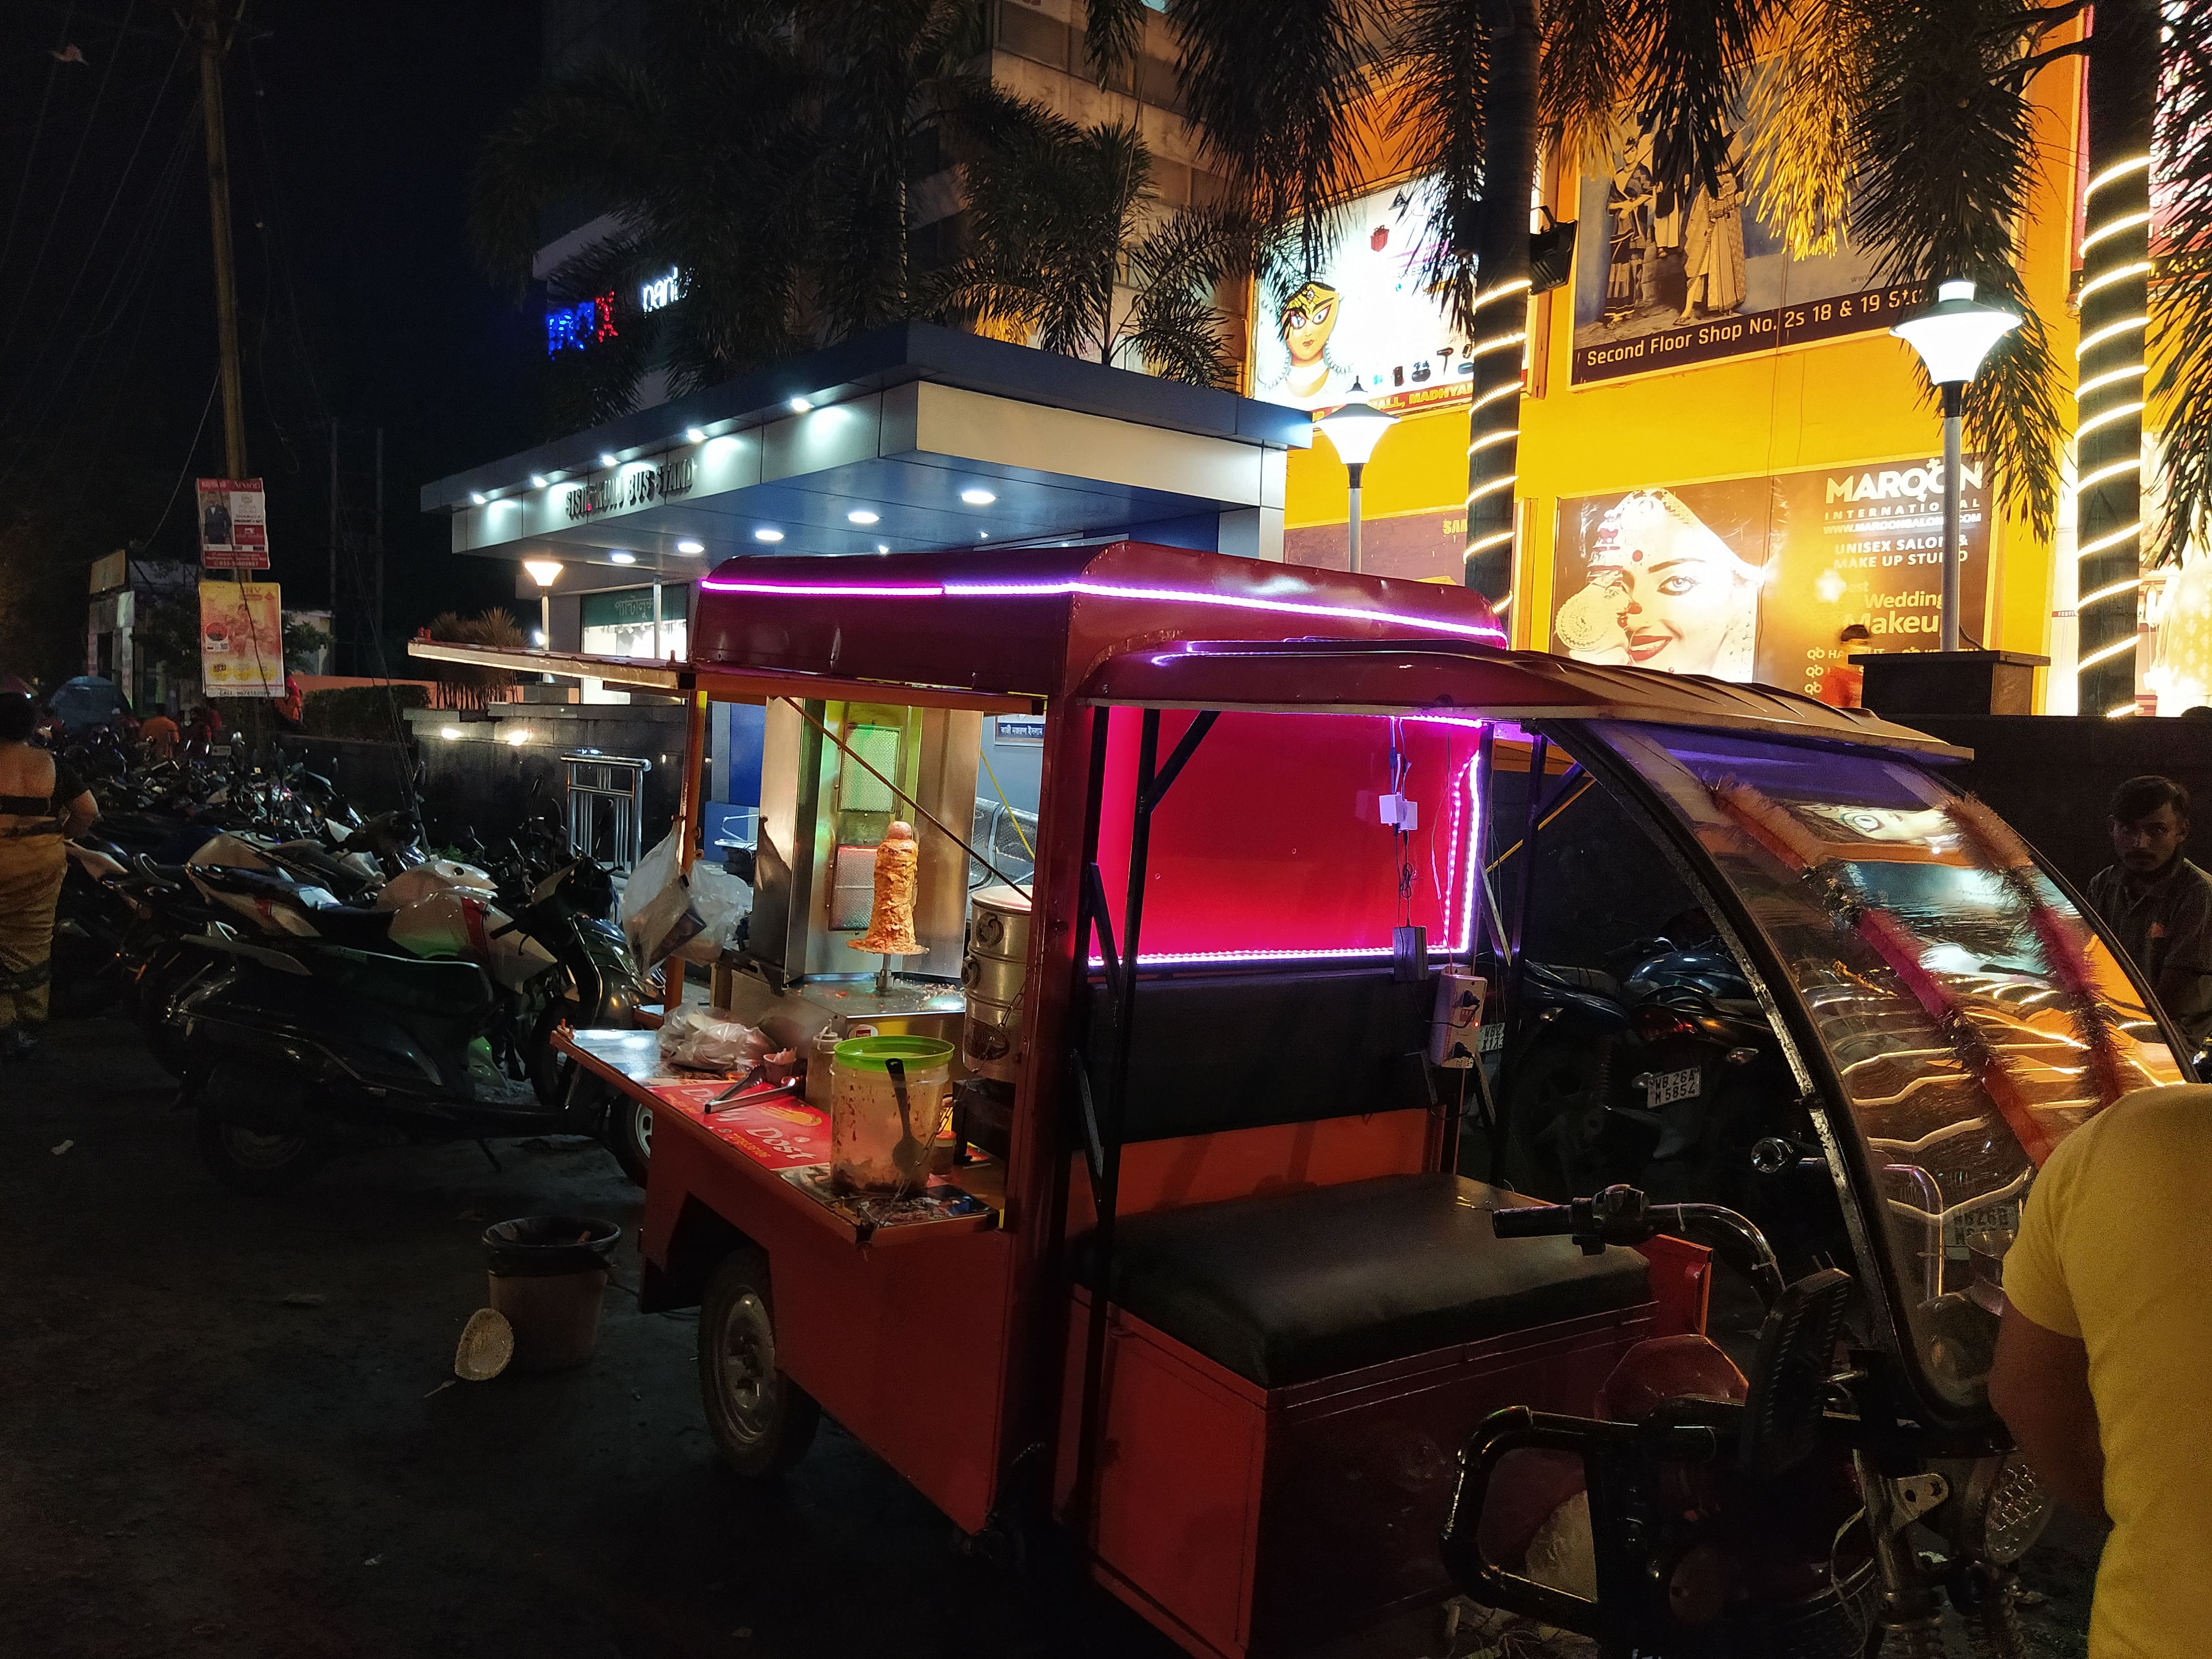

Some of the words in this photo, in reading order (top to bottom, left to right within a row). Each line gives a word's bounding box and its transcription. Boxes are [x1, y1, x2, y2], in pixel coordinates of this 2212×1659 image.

[1587, 338, 1644, 367] Second
[1650, 332, 1692, 354] Floor
[1698, 323, 1742, 347] Shop
[1750, 316, 1778, 334] No.
[1813, 304, 1831, 322] 18
[1839, 300, 1853, 317] &
[1861, 295, 1880, 313] 19
[628, 469, 650, 500] BUS
[655, 458, 694, 495] STAND
[1825, 498, 1980, 521] INTERNATIOAL
[1833, 557, 1876, 570] MAKE
[1882, 555, 1903, 567] UP
[1907, 550, 1968, 565] STUO
[1835, 540, 1891, 555] UNISEX
[1843, 611, 1943, 638] Makeu
[745, 1126, 816, 1160] Dost
